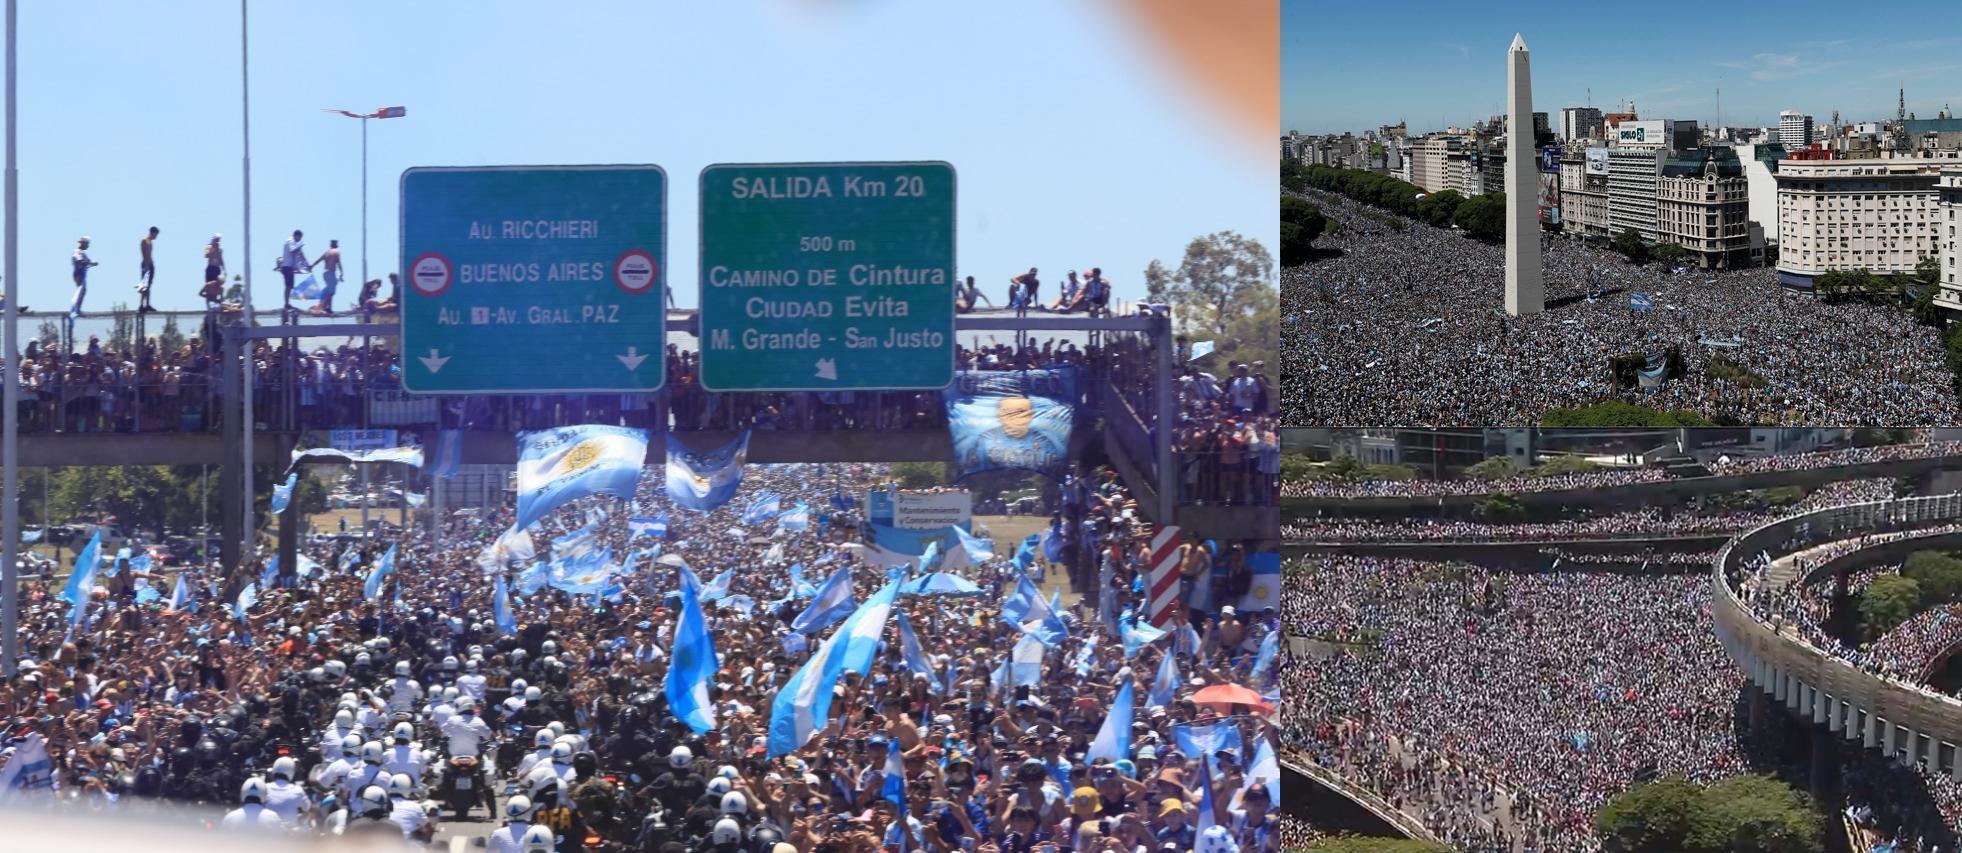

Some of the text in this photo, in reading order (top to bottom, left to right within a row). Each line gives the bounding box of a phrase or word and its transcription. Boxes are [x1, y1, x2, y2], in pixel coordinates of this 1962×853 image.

[1620, 130, 1637, 140] SIGLO
[731, 175, 925, 199] SALIDA Km 20
[502, 220, 599, 239] RICCHIERI
[800, 236, 856, 252] 500 m
[460, 262, 604, 283] BUENOS AIRES
[709, 264, 945, 288] CAMINO DE Cintura
[582, 304, 620, 324] PAZ
[746, 296, 909, 319] CIUDAD Evita
[711, 329, 736, 350] M.
[742, 327, 821, 350] Grande
[845, 327, 877, 348] San
[883, 327, 944, 348] Justo
